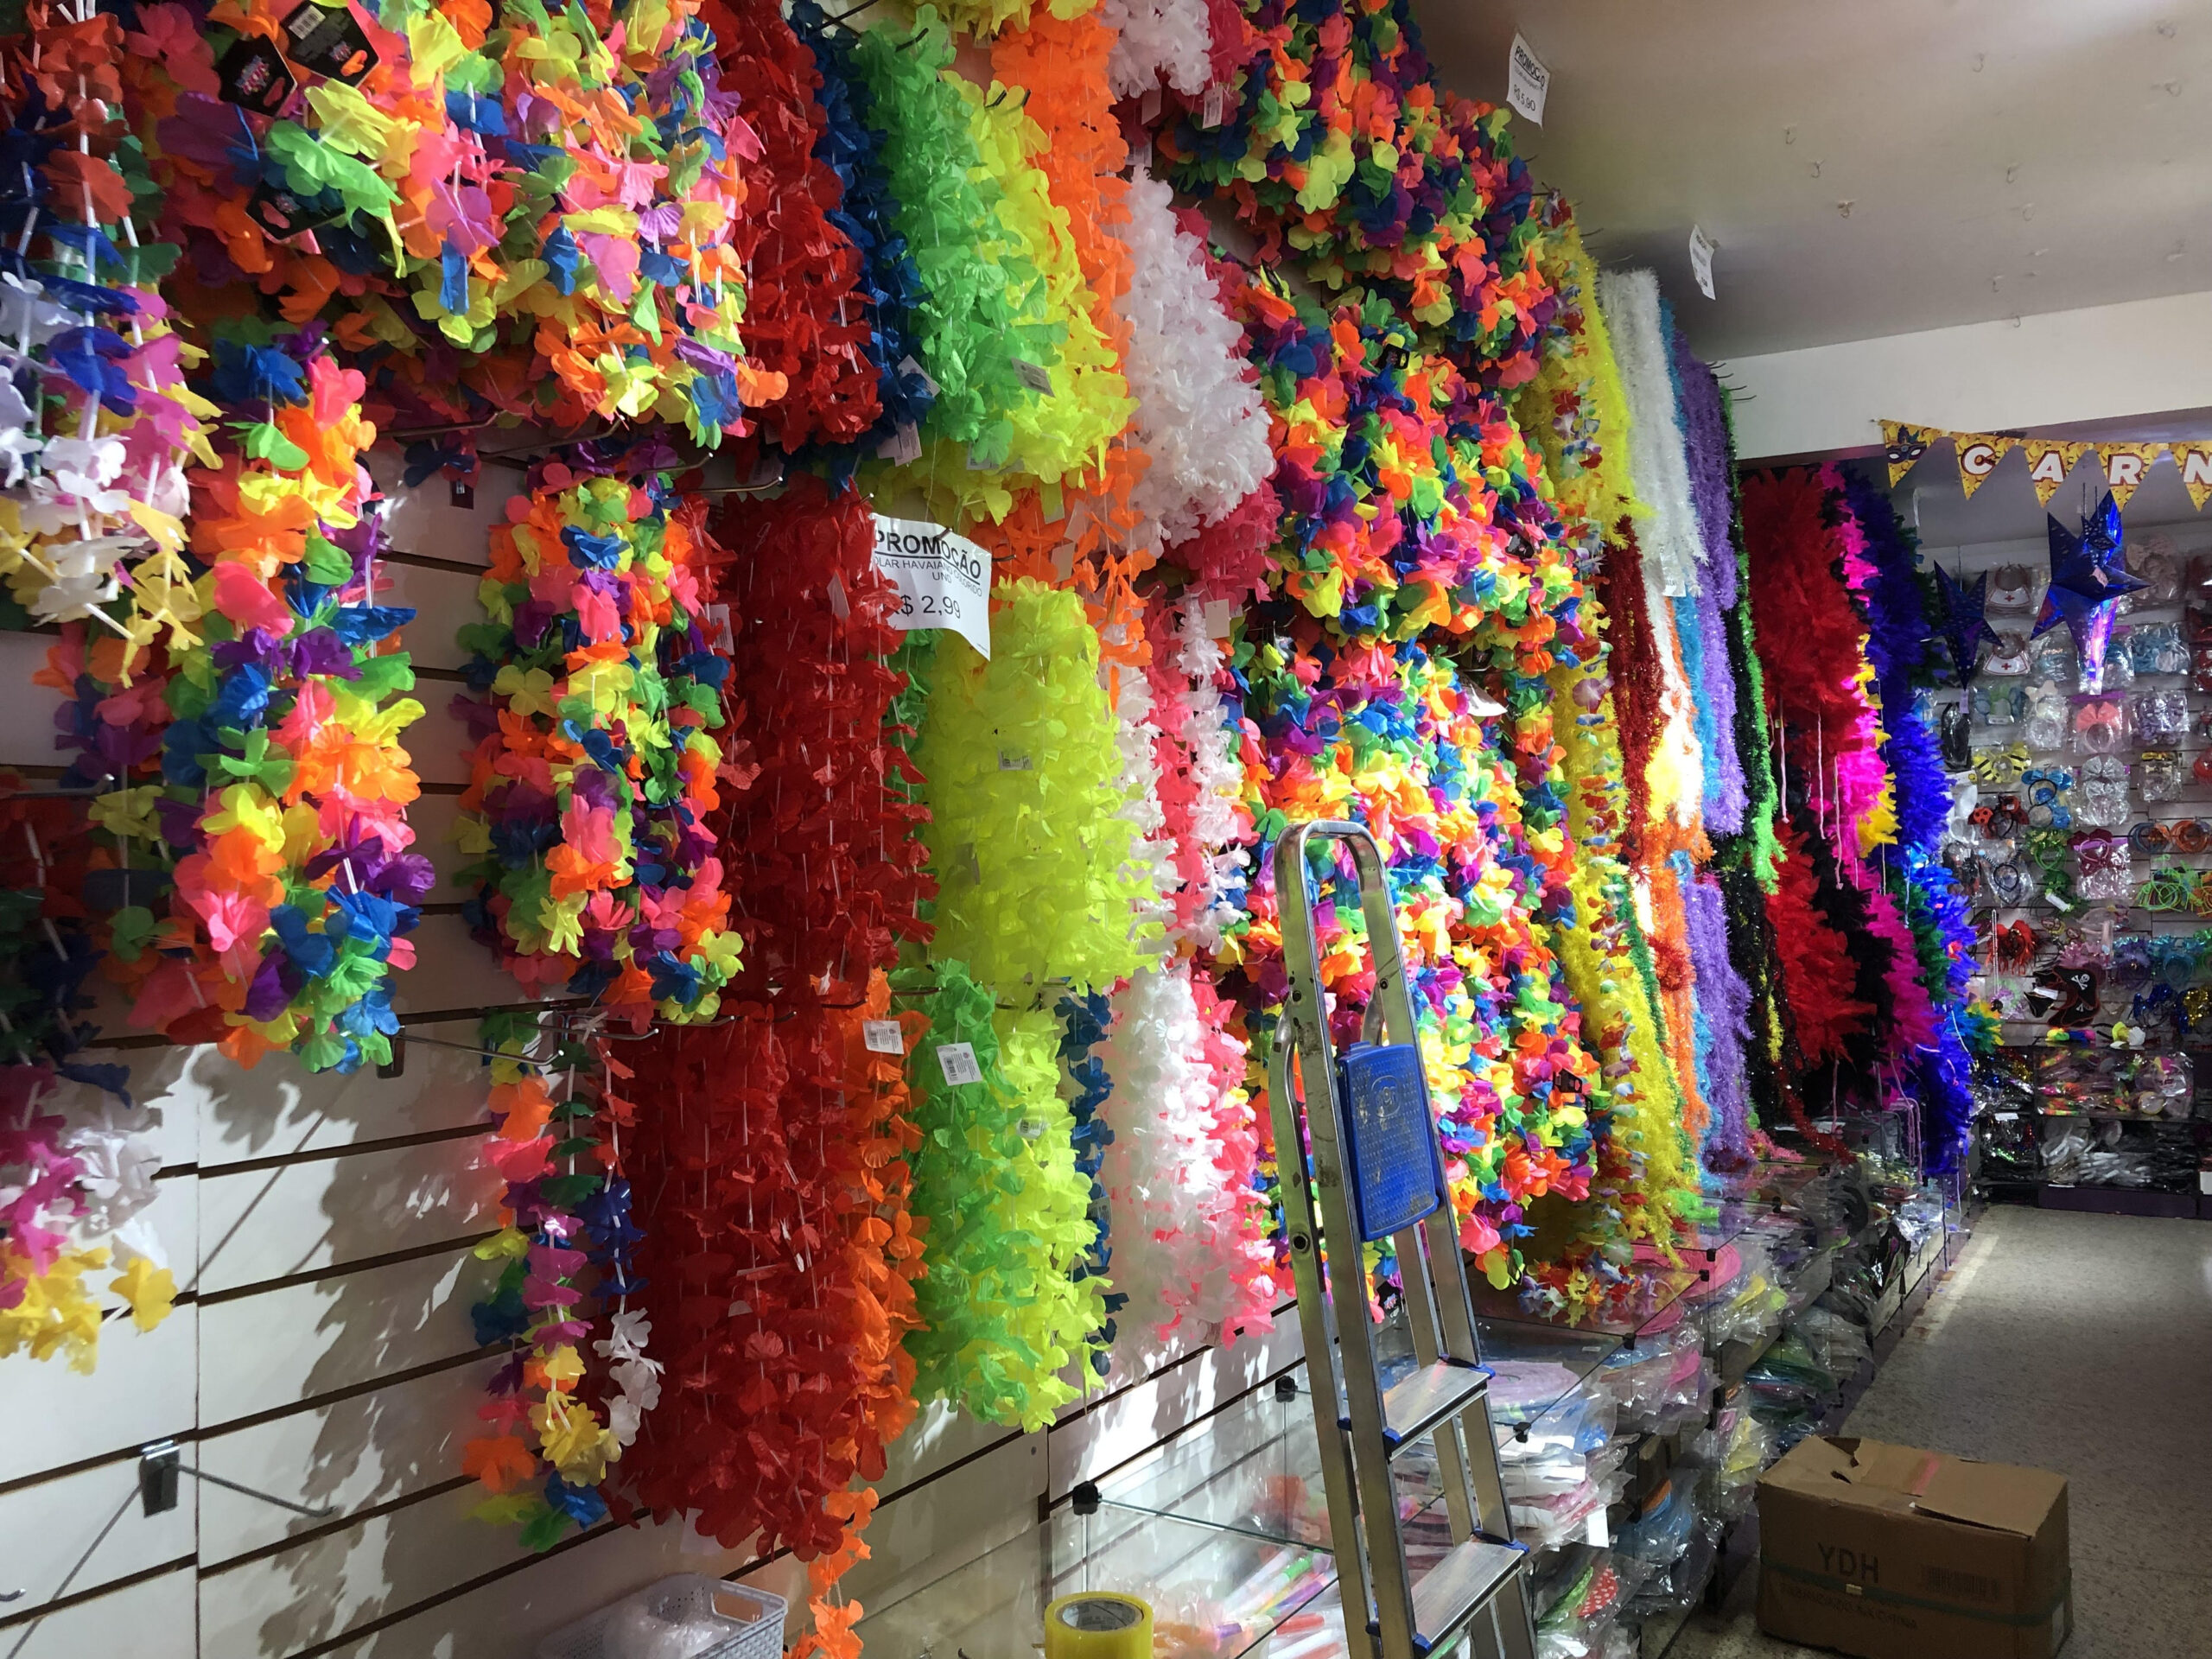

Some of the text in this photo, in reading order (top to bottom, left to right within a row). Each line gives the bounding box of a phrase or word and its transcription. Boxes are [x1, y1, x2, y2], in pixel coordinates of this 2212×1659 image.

[902, 559, 953, 575] HAVAIANO
[931, 571, 952, 584] UND
[921, 594, 961, 620] 2,99
[1817, 1541, 1879, 1584] YDH
